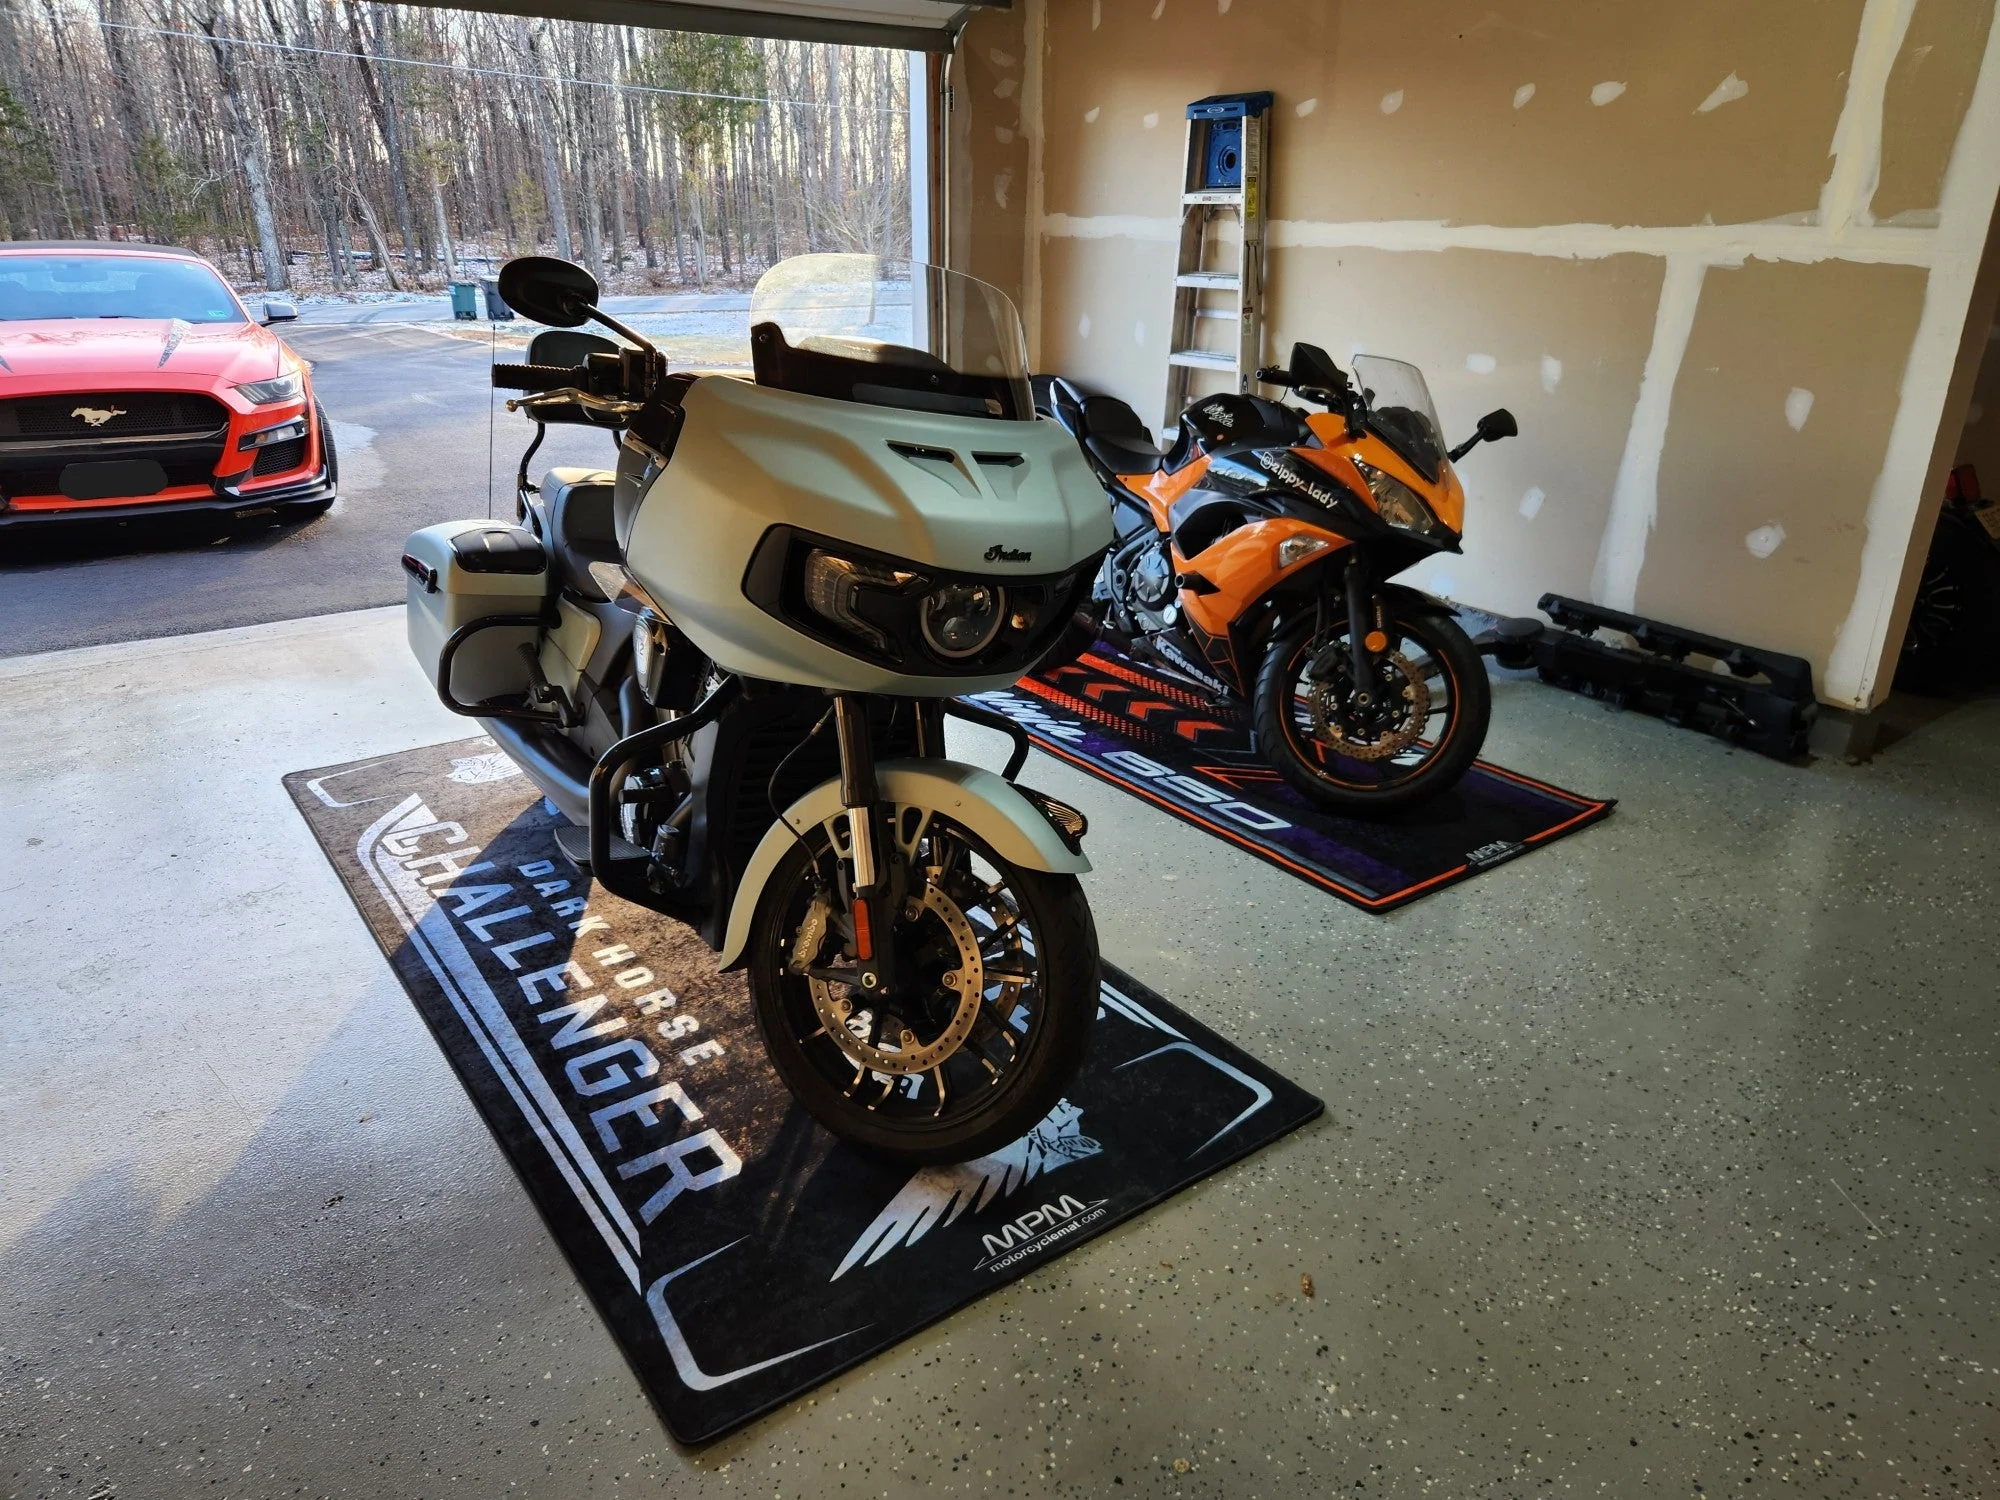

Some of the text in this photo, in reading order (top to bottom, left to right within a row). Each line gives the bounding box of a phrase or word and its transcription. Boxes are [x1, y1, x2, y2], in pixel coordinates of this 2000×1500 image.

[984, 544, 1032, 563] Indian
[1155, 635, 1229, 696] Kawasaki
[1101, 750, 1293, 830] 650
[517, 859, 725, 1067] DARK HORSE
[797, 918, 818, 959] brembo
[381, 820, 743, 1226] CHALLENGER
[981, 1194, 1087, 1257] MPM
[989, 1207, 1107, 1273] motorcyclemat.com
